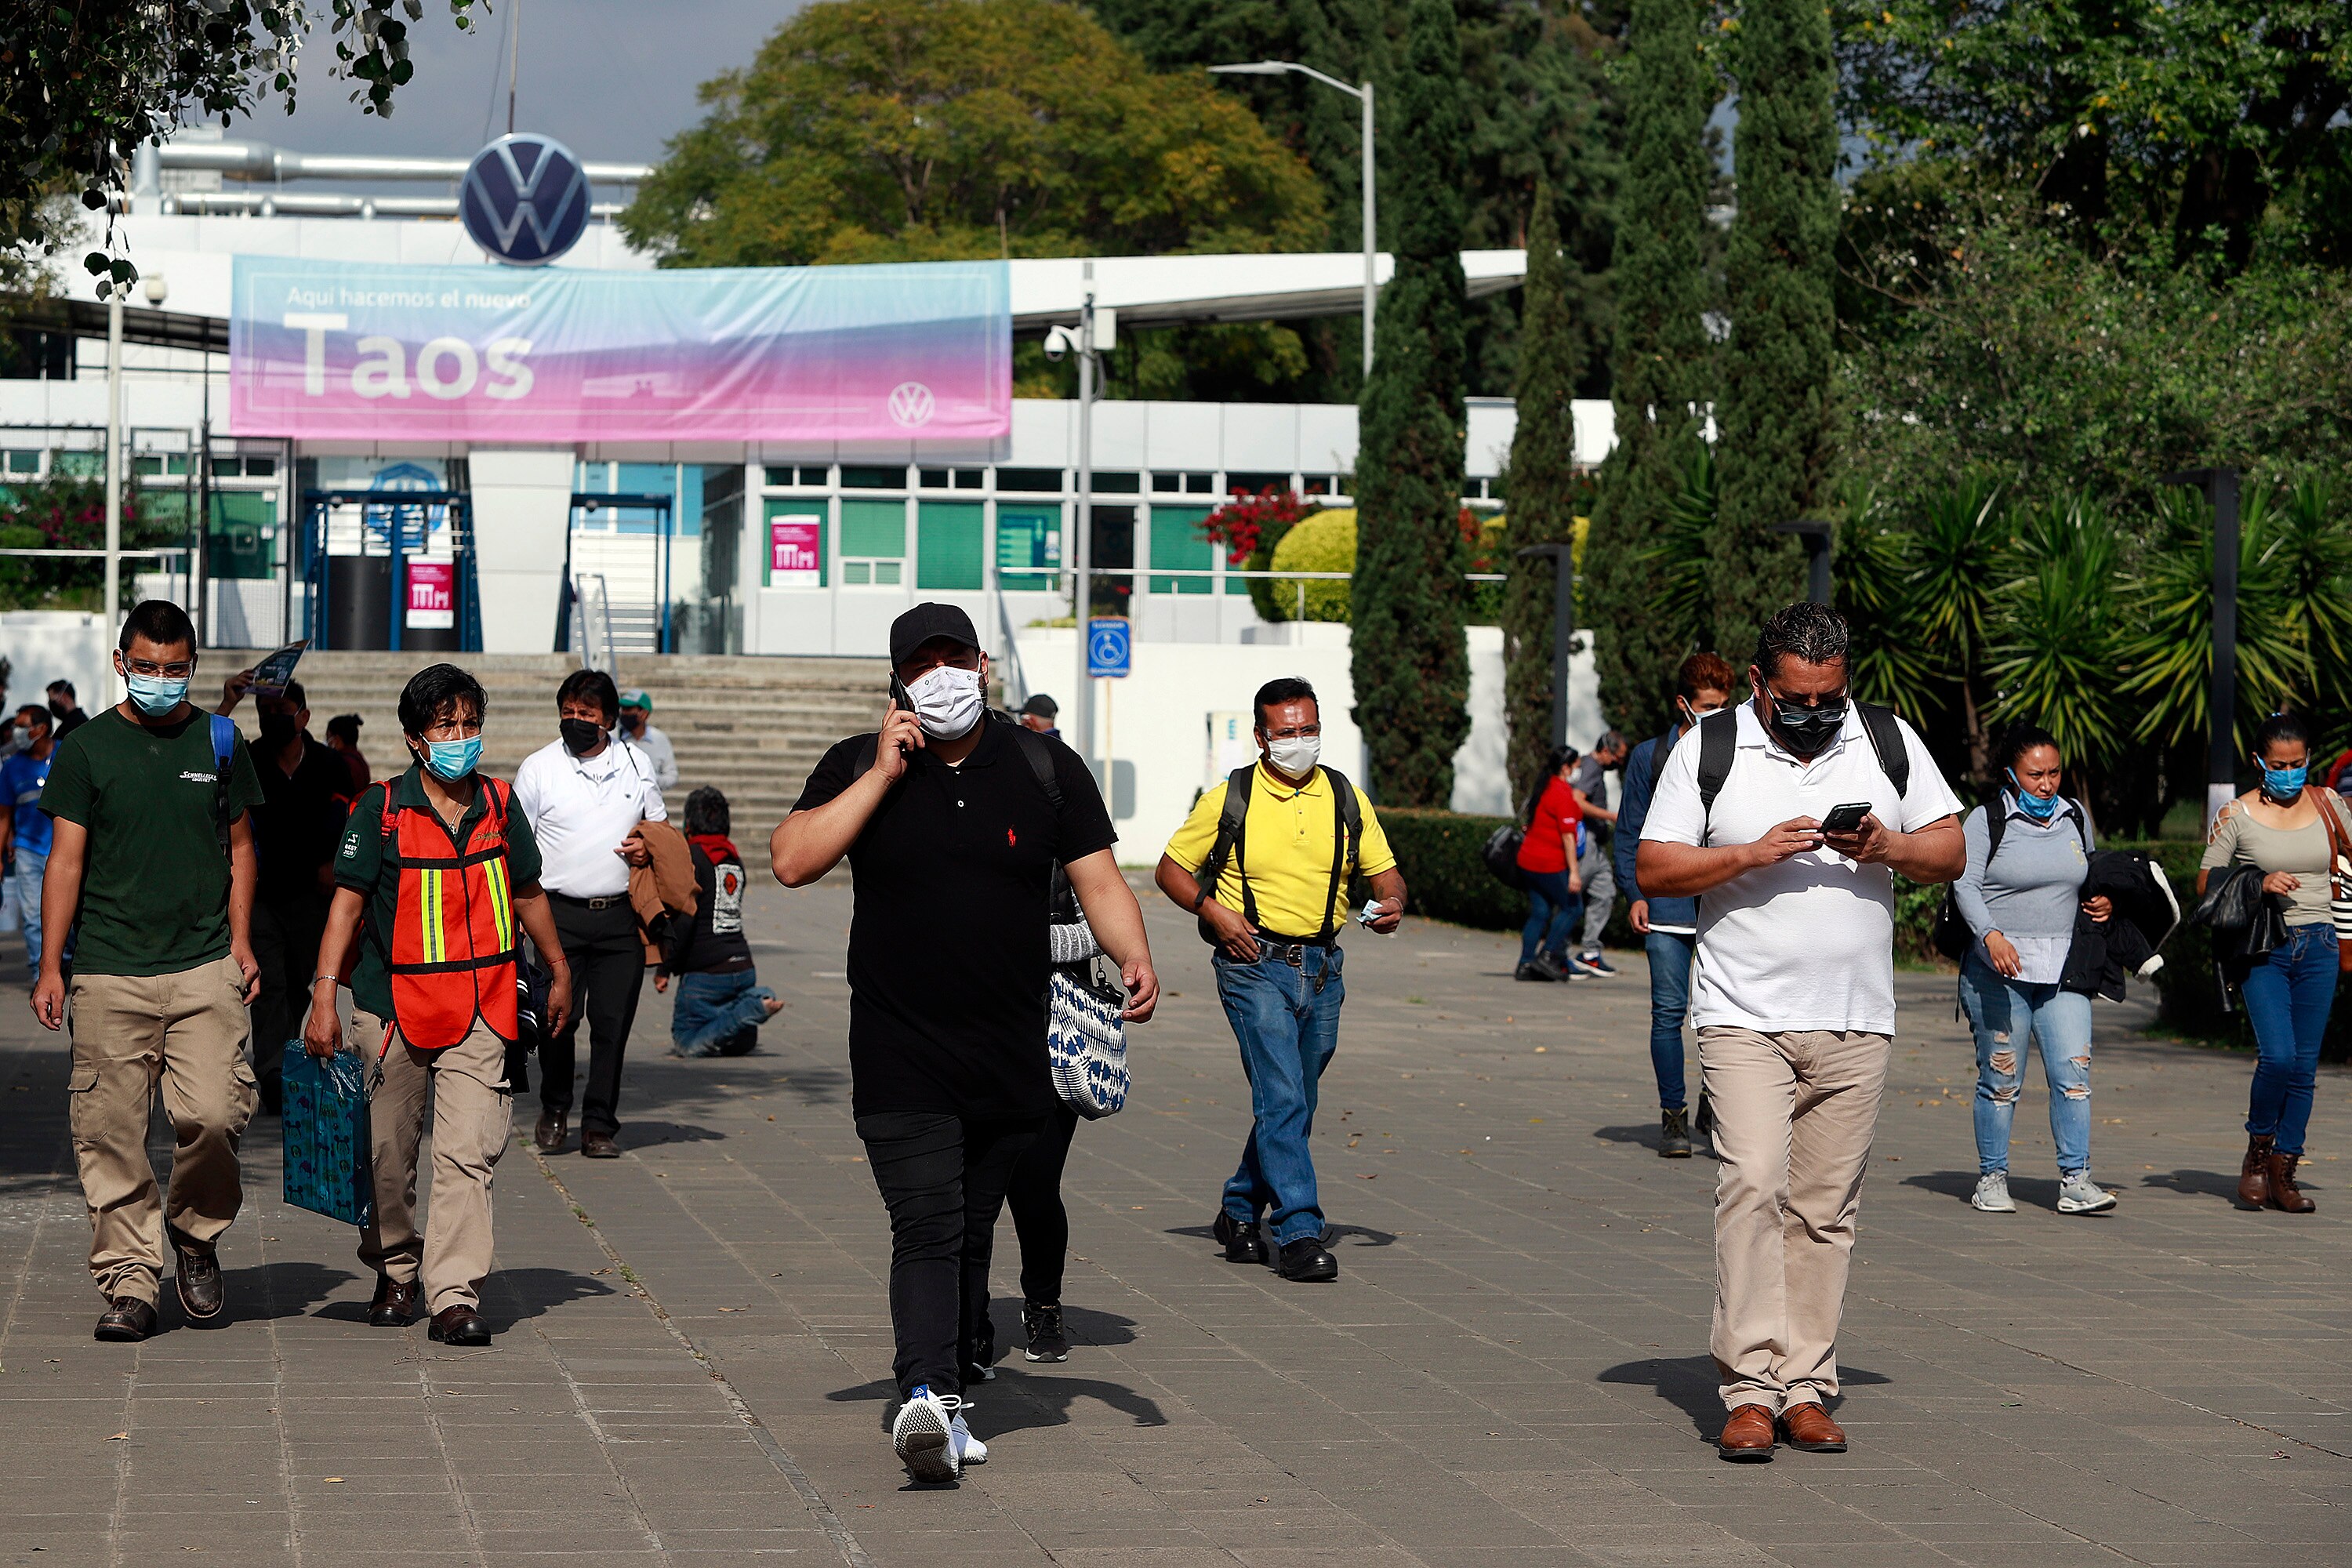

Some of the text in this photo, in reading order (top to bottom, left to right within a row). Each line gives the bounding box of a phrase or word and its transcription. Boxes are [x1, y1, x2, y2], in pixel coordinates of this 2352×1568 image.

[339, 287, 434, 307] hacemos
[441, 289, 459, 308] el
[465, 292, 532, 308] nuevo
[283, 313, 535, 400] Taos
